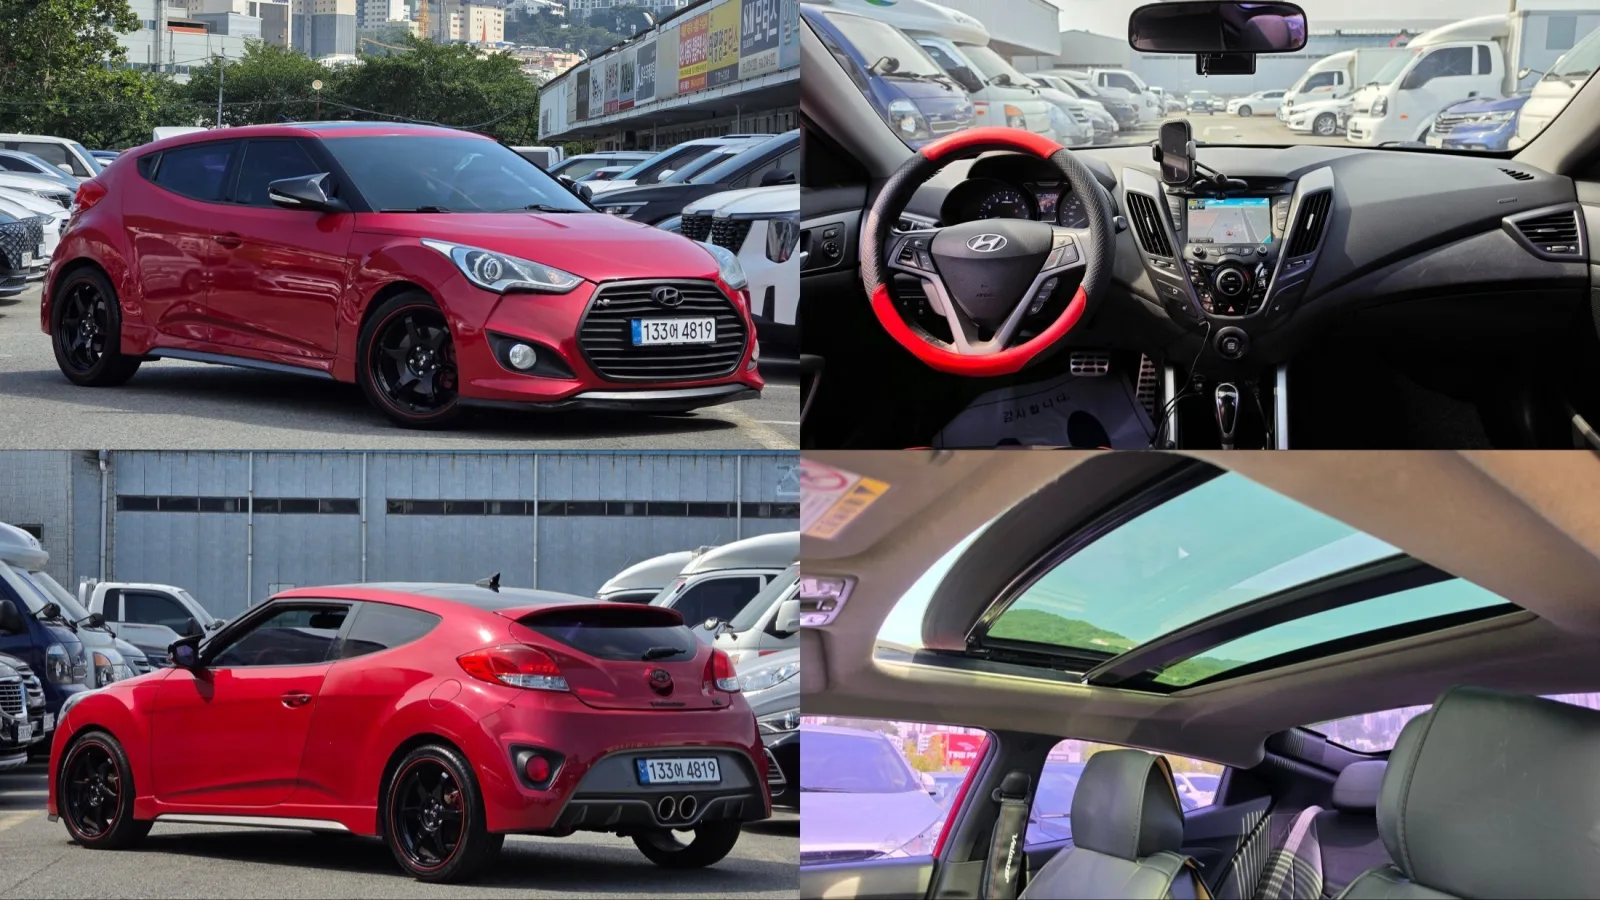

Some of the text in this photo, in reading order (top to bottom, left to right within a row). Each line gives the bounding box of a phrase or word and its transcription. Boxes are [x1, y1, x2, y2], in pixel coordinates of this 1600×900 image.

[643, 321, 713, 341] 133어 4819
[649, 761, 716, 780] 133어 4819
[1004, 833, 1018, 884] Veloster
